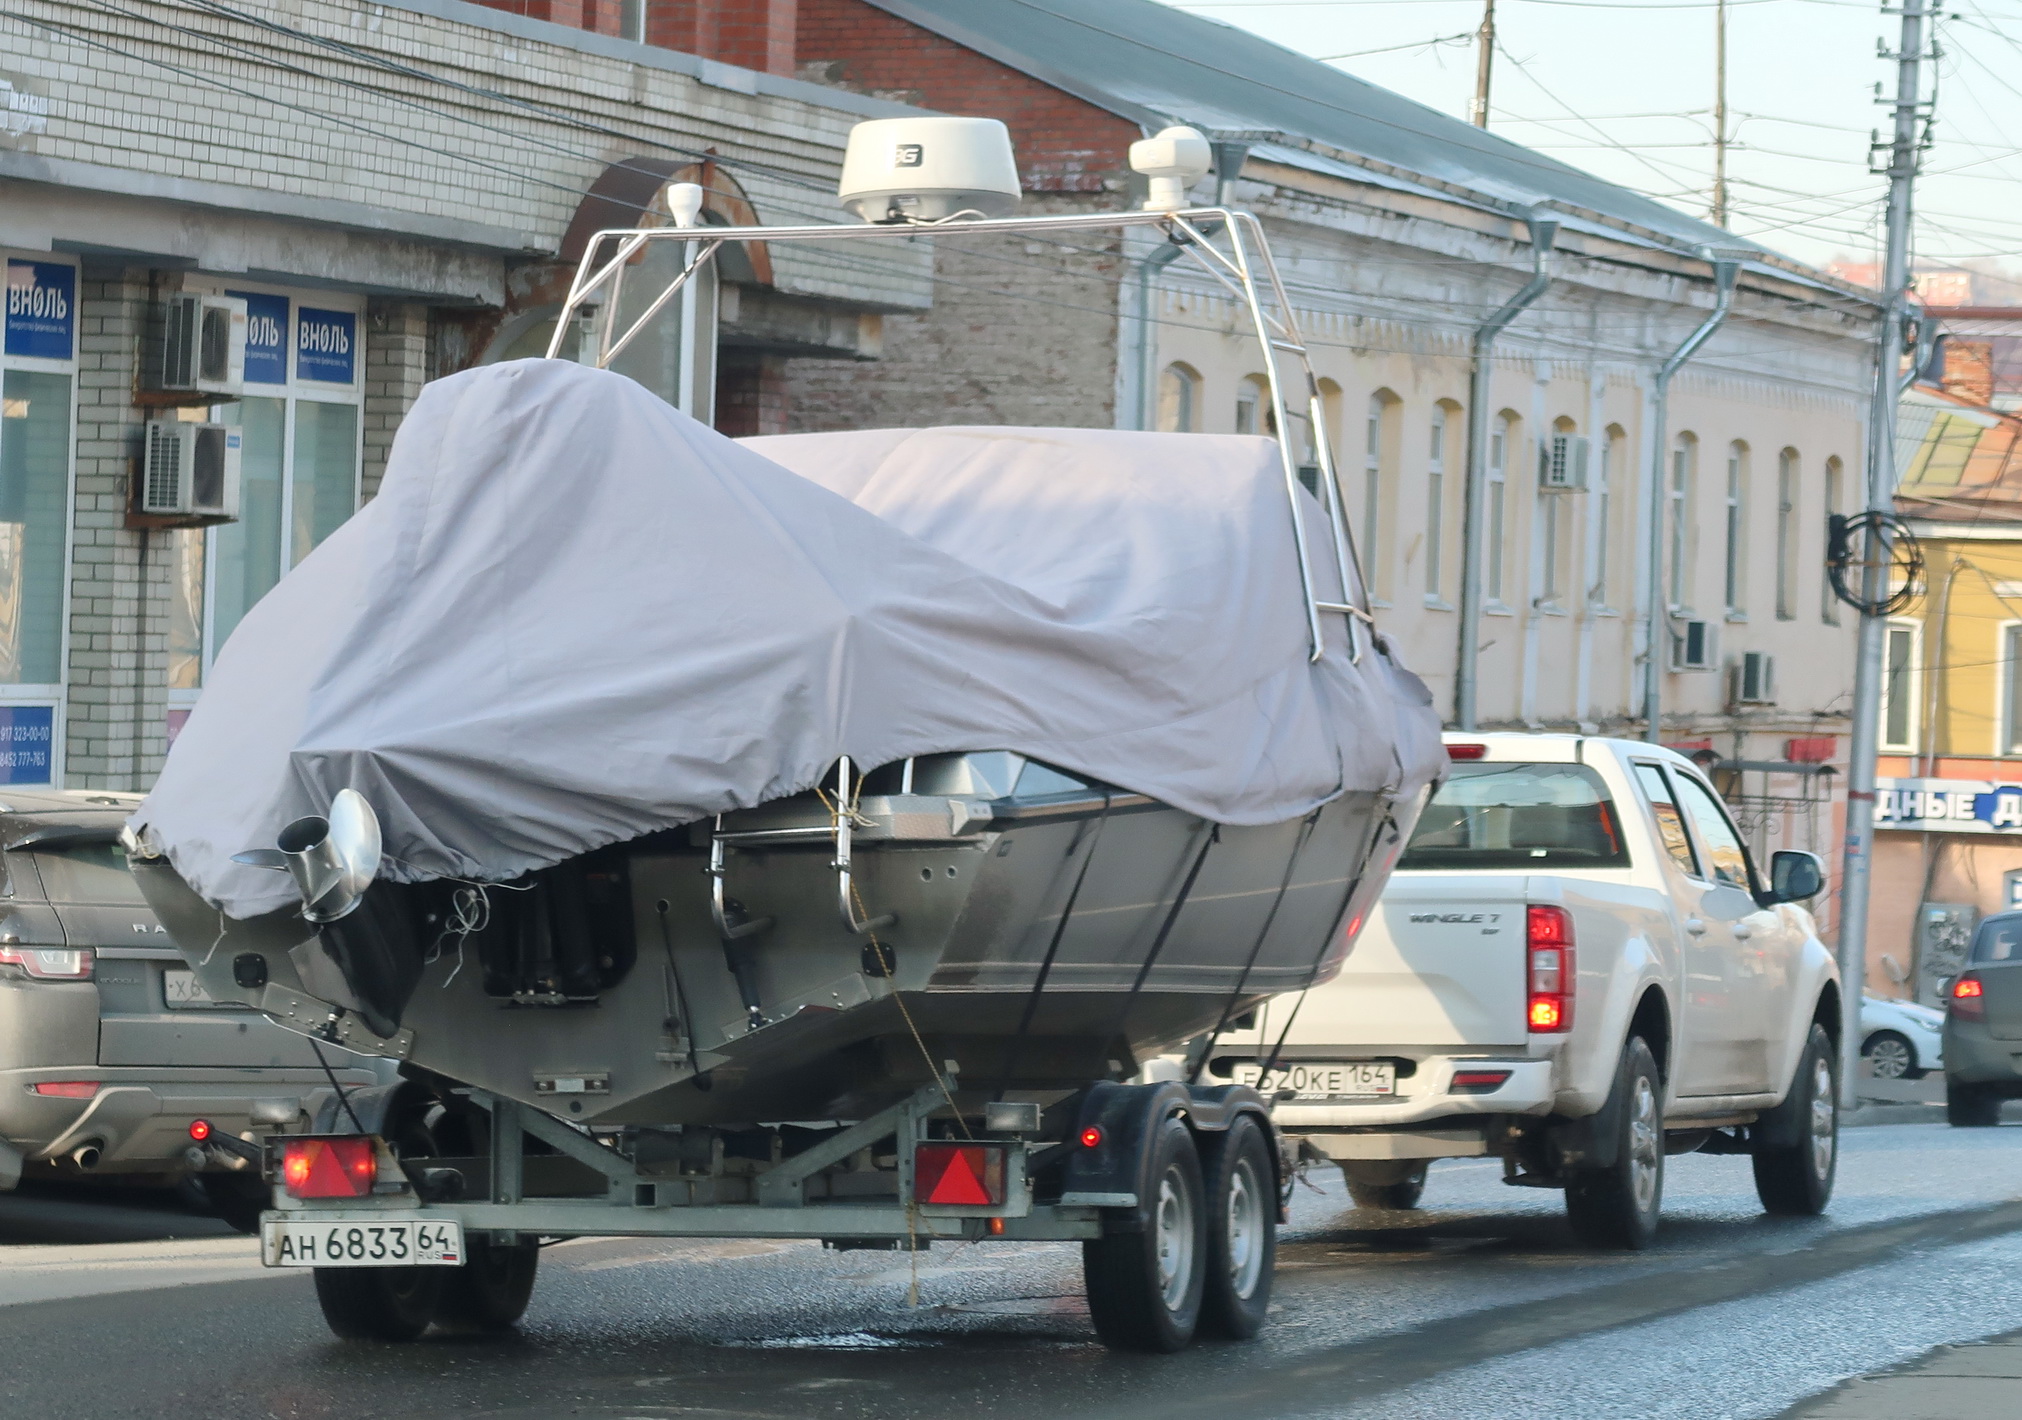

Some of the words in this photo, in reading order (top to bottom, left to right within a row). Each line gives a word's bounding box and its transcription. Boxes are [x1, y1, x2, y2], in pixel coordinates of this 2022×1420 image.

[14, 726, 50, 741] 323-00-00
[18, 751, 46, 767] 777-763
[1873, 789, 1976, 821] ДНЫЕ
[1409, 913, 1485, 923] WINGLE
[1489, 913, 1501, 923] 7
[1349, 1064, 1388, 1083] 164
[280, 1235, 316, 1260] АН
[326, 1227, 409, 1260] 6833
[417, 1225, 449, 1250] 64
[417, 1251, 441, 1260] RUS
